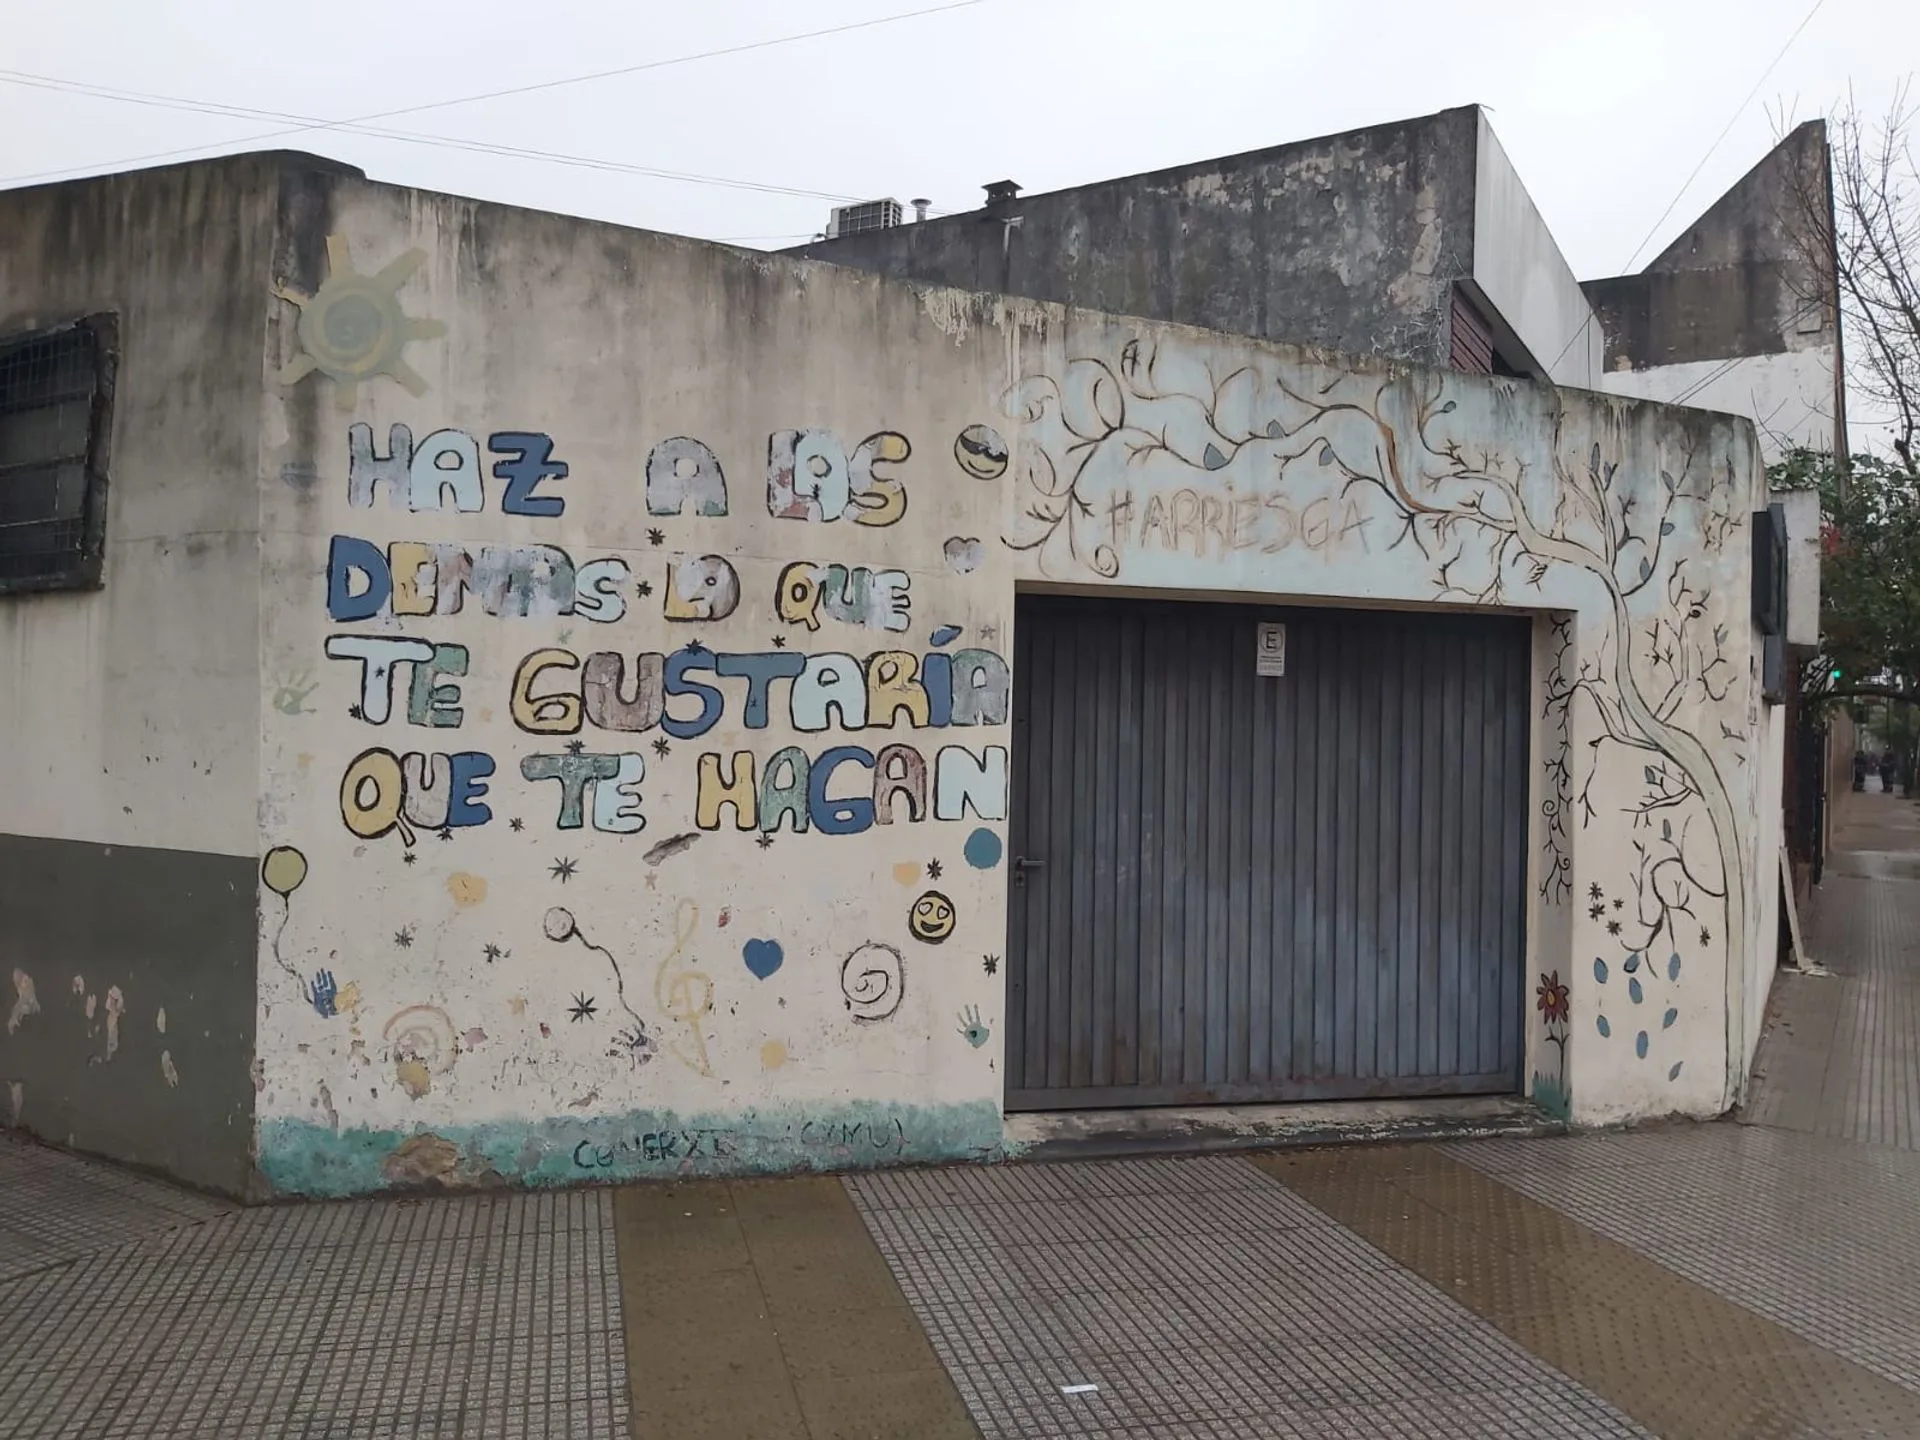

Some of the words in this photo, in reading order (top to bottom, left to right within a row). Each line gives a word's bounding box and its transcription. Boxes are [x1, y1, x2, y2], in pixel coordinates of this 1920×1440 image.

[348, 422, 569, 517] HAZ
[646, 436, 729, 517] A
[767, 428, 912, 527] LAS
[775, 561, 912, 633] QUE
[1266, 631, 1277, 650] E
[324, 634, 470, 729] TE
[509, 624, 1010, 740] GUSTARÍA
[340, 747, 496, 848] QUE
[520, 751, 647, 834] TE
[695, 743, 1008, 835] HAGAN
